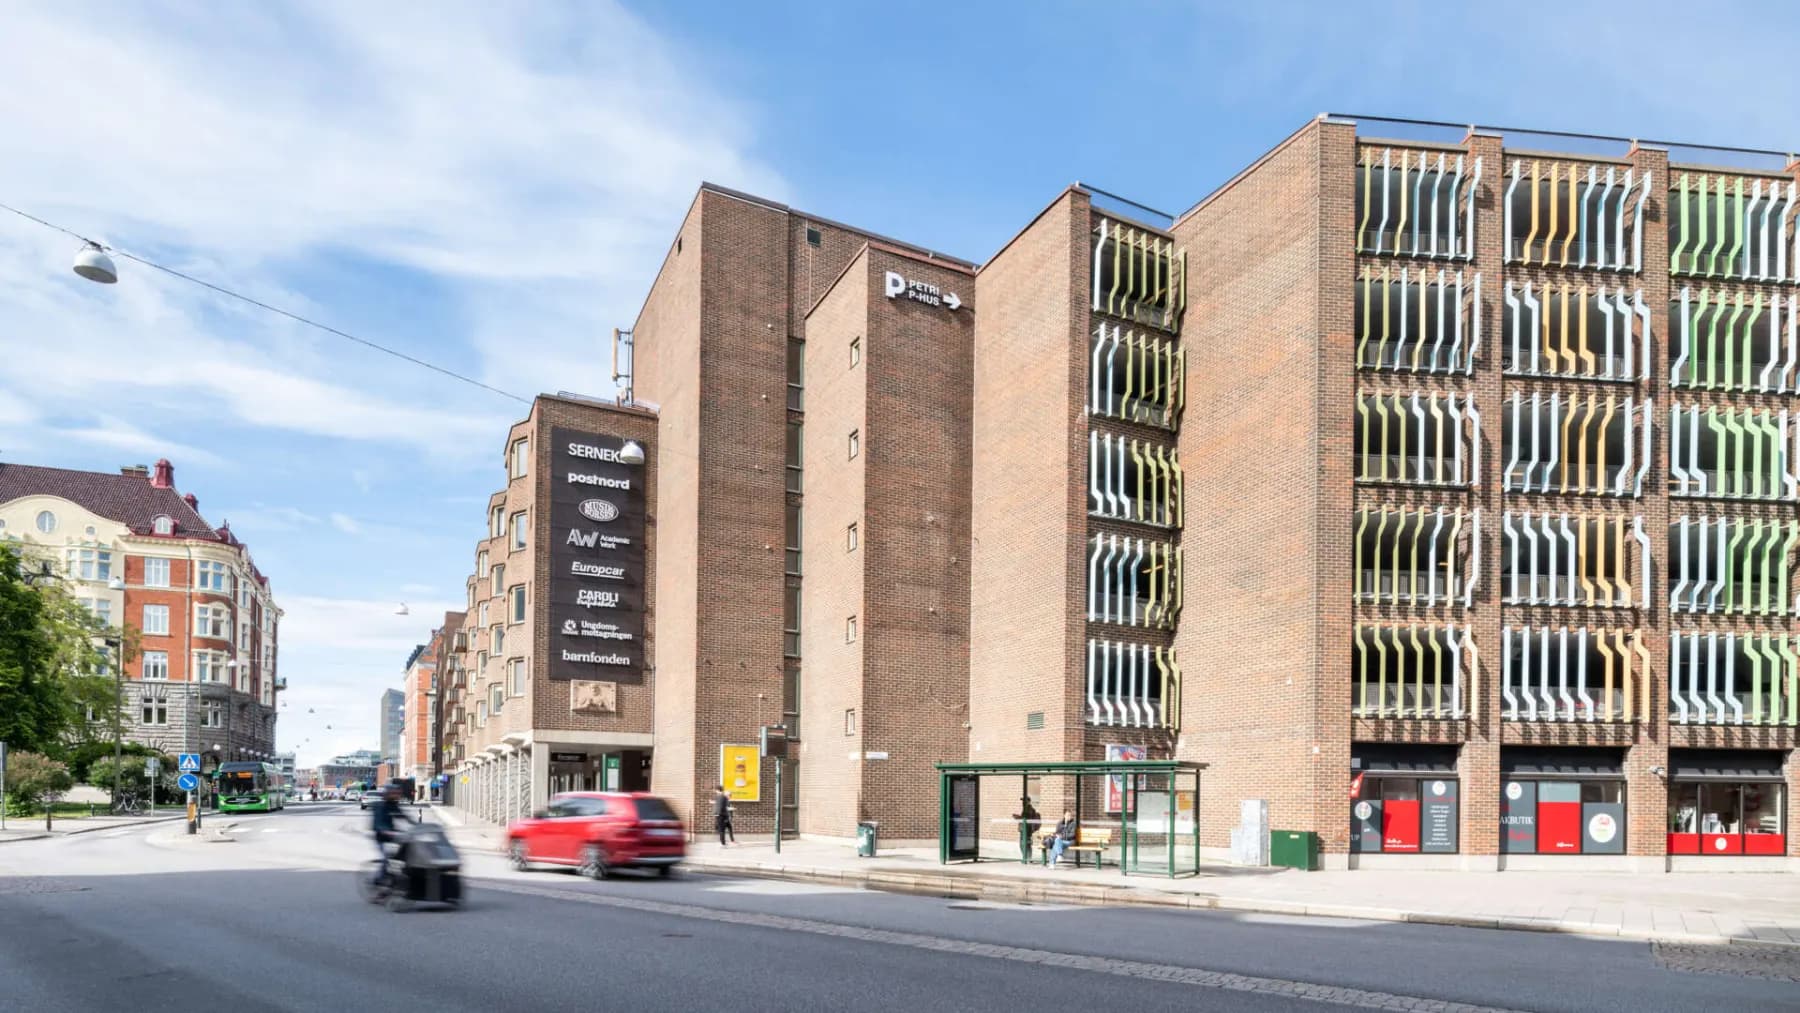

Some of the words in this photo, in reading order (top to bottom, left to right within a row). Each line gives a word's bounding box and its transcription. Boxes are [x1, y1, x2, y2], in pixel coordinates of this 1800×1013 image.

[909, 280, 939, 296] PETRI
[909, 290, 940, 306] P-HUS
[568, 443, 628, 464] SERNEK
[567, 472, 630, 490] postnord
[571, 561, 625, 577] Europcar
[578, 589, 619, 603] CAROLI
[562, 649, 631, 666] barnfonden
